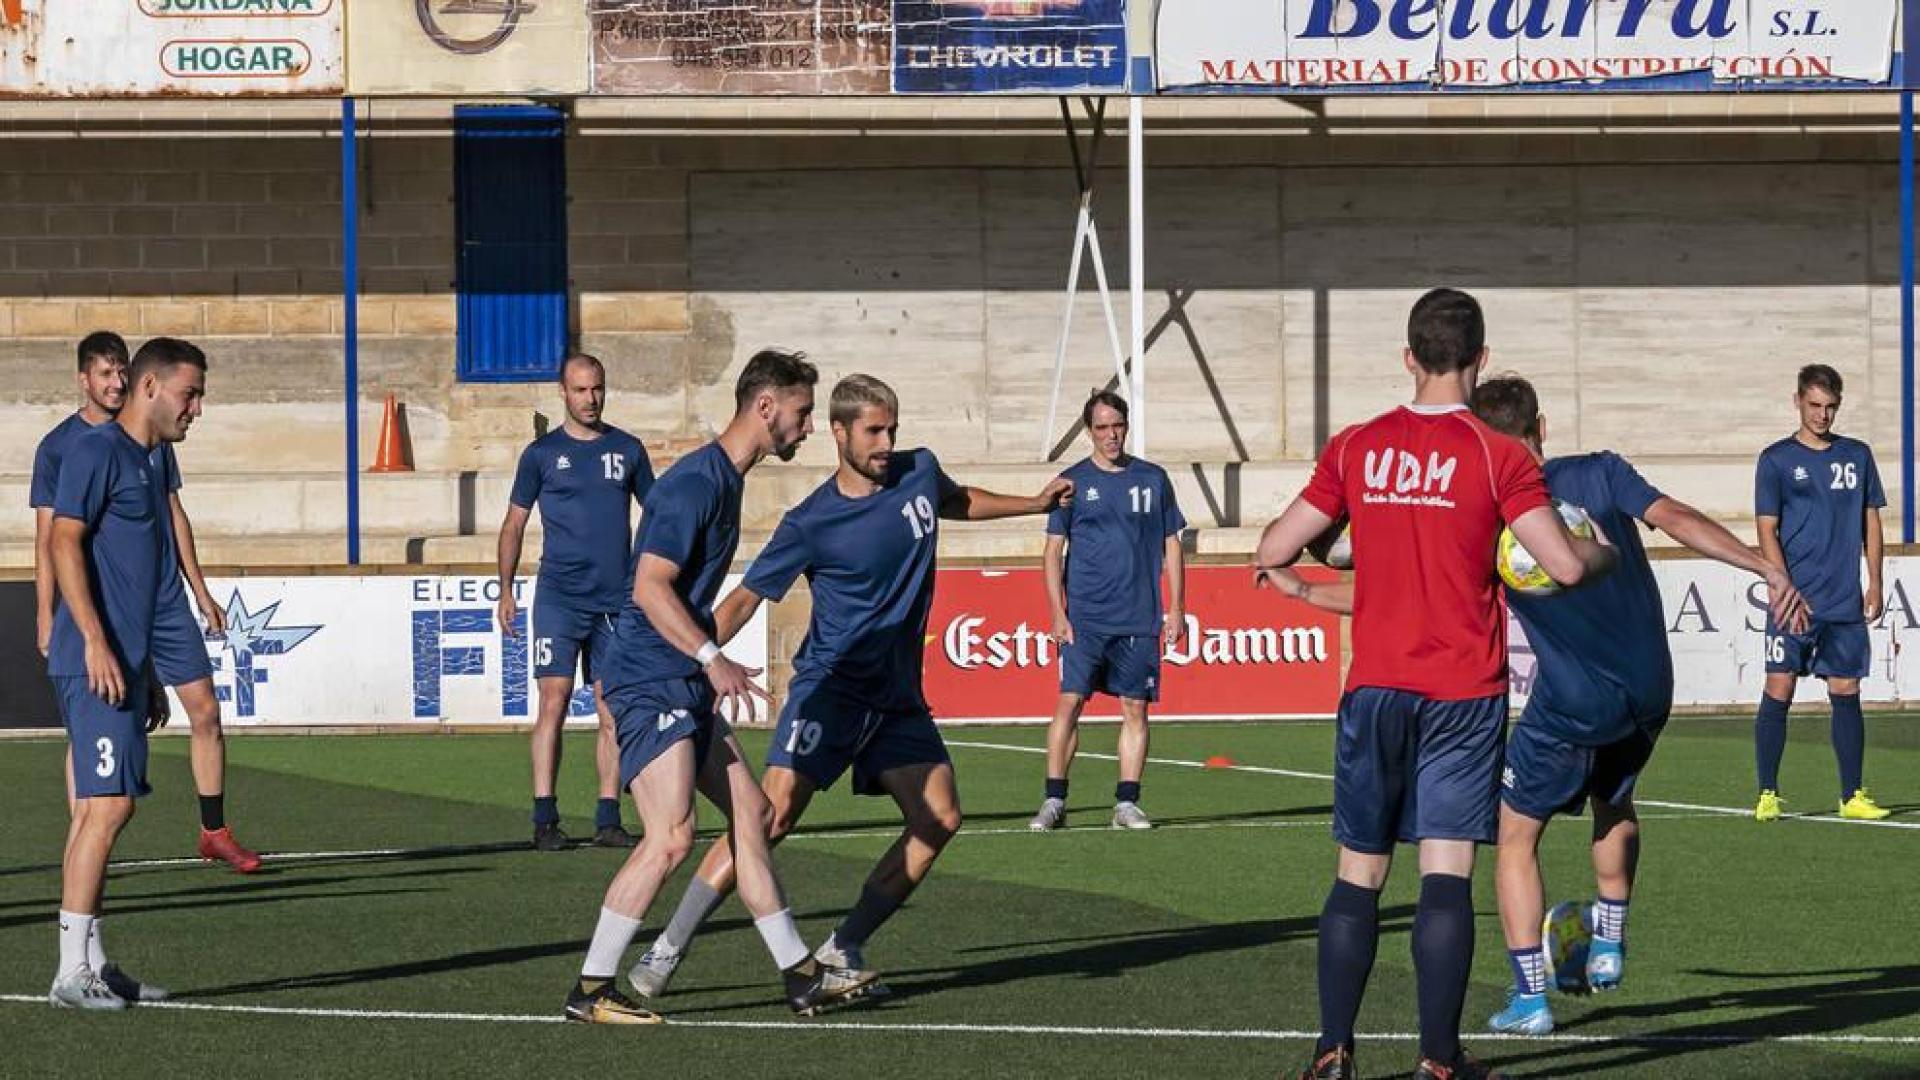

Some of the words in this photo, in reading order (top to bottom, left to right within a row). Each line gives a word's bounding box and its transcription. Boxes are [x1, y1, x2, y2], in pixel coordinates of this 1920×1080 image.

[1770, 10, 1838, 37] S.L.
[177, 47, 294, 71] HOGAR
[770, 47, 811, 68] 012
[908, 45, 1117, 68] CHEVROLET
[1200, 59, 1422, 85] MATERIAL
[1441, 58, 1489, 83] DE
[601, 452, 625, 481] 15
[1364, 447, 1457, 493] UDM
[1830, 462, 1857, 490] 26
[1128, 485, 1151, 513] 11
[902, 495, 936, 539] 19
[534, 637, 552, 666] 15
[944, 613, 1056, 670] Estr
[1163, 614, 1328, 665] Damm
[785, 718, 823, 756] 19
[96, 736, 116, 778] 3
